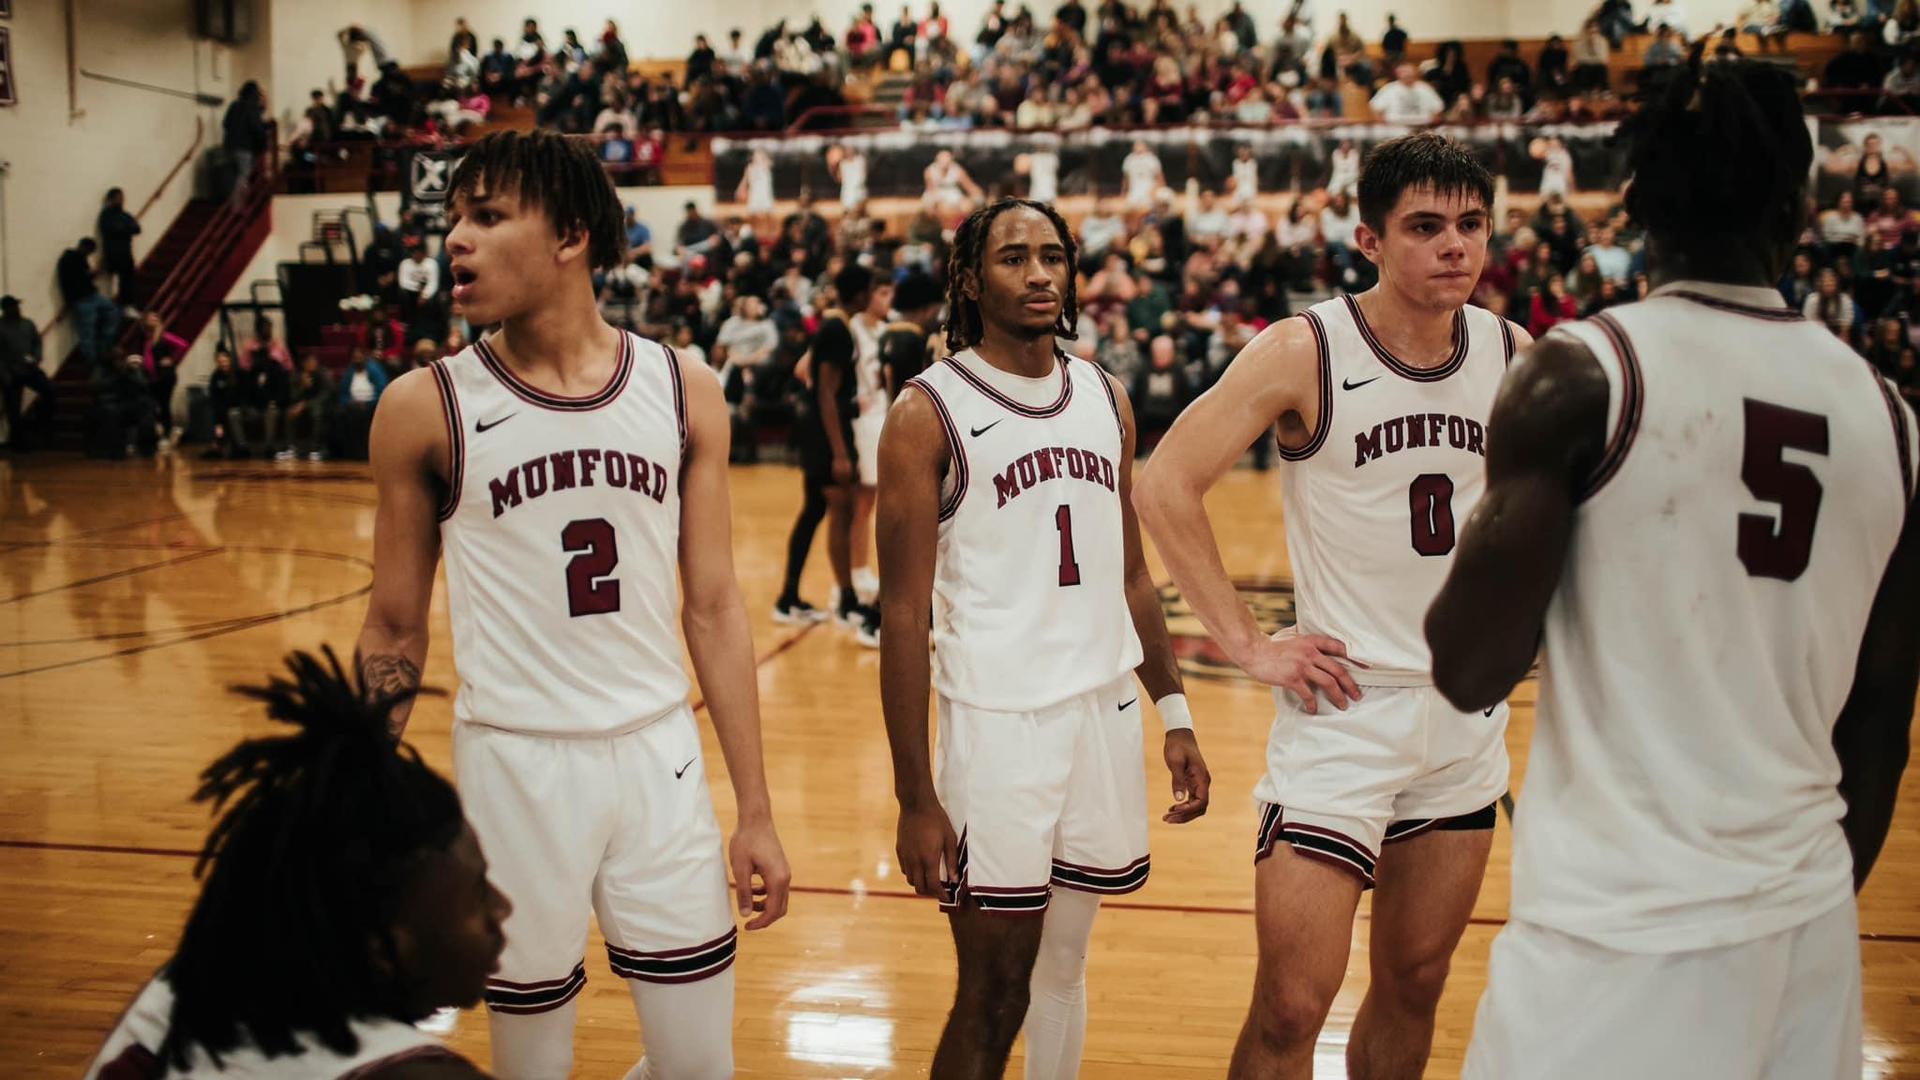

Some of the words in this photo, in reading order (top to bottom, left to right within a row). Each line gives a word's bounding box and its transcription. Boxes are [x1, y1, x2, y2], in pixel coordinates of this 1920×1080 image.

[993, 447, 1115, 509] MUNFORD
[1355, 413, 1488, 468] MUNFOR
[489, 449, 667, 519] MUNFORD
[1409, 474, 1455, 556] 0
[1737, 397, 1829, 583] 5
[561, 518, 620, 617] 2
[1055, 504, 1080, 587] 1
